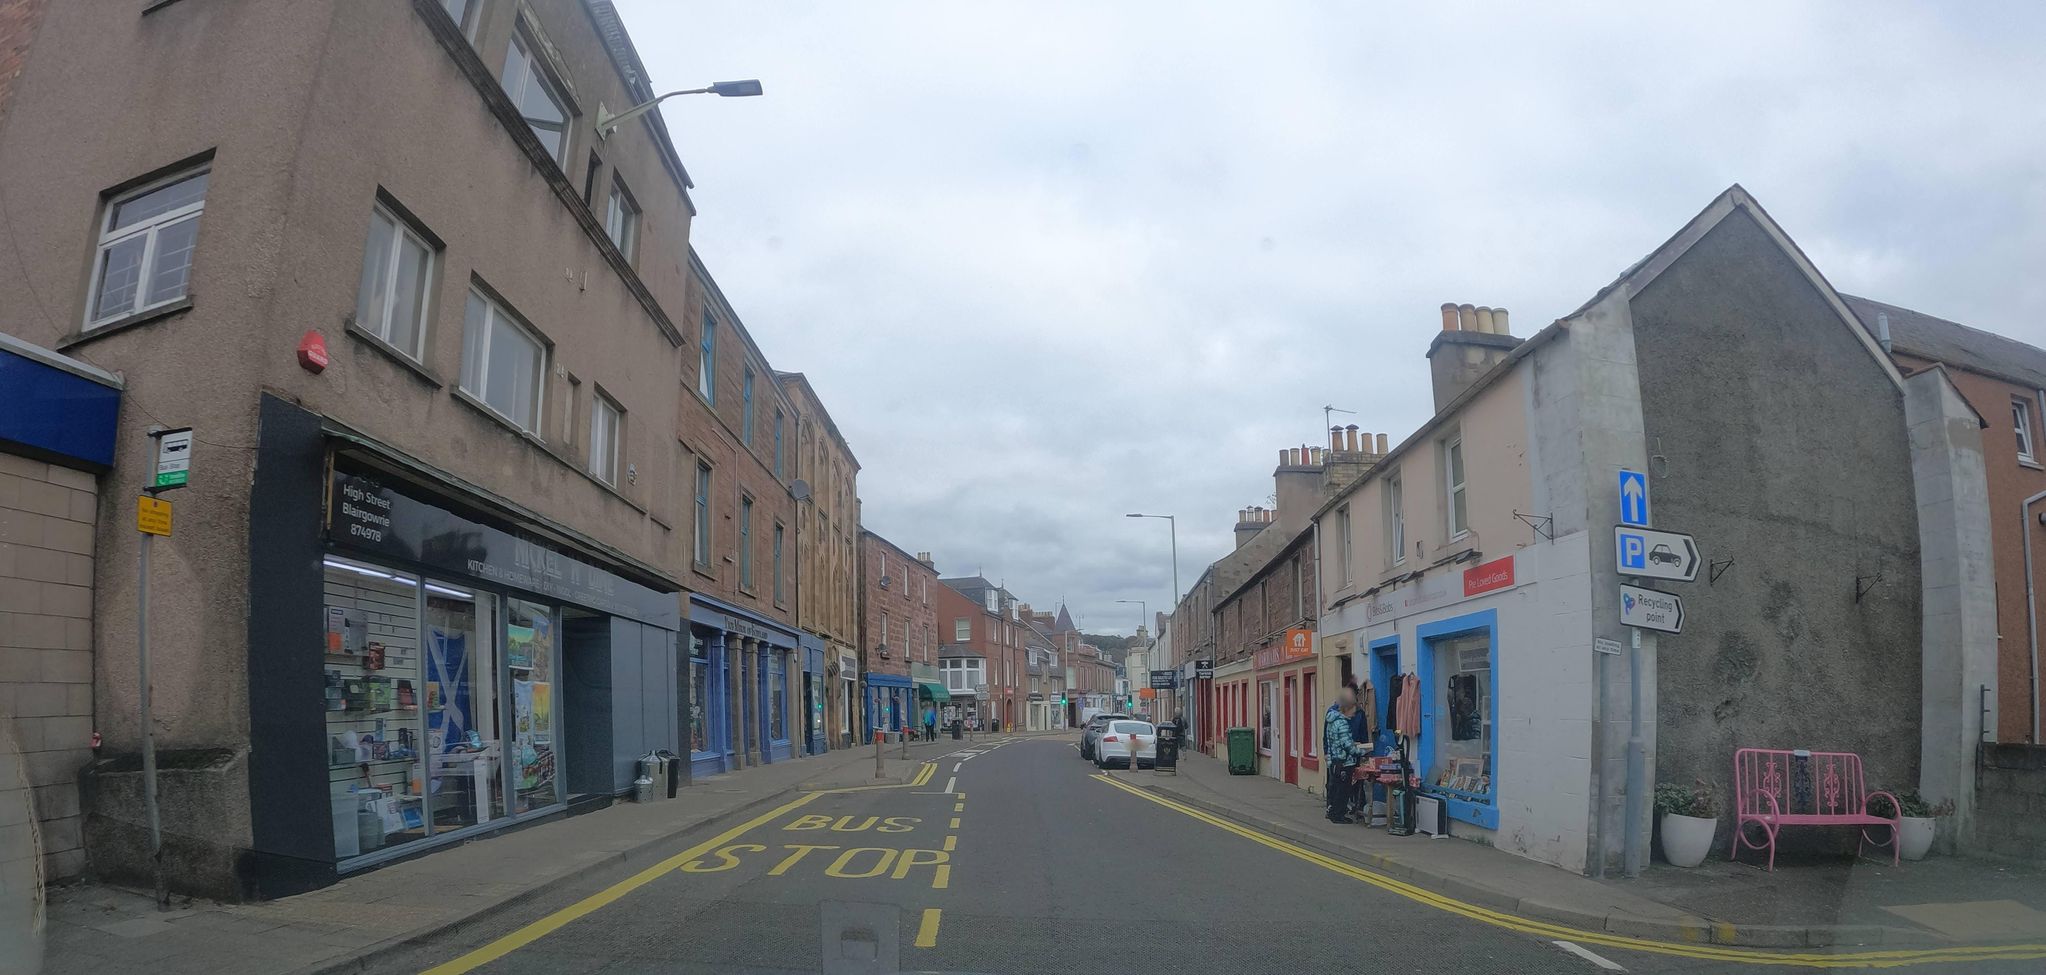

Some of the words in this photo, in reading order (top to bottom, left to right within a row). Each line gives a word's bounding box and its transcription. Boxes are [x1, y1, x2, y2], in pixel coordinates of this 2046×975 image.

[343, 484, 364, 502] High
[365, 492, 391, 510] Street
[342, 502, 390, 527] Blairgowrie
[350, 523, 382, 542] 874978
[1625, 537, 1642, 566] P
[467, 559, 499, 577] KITCHEN
[1477, 573, 1491, 587] Loved
[1492, 570, 1508, 583] Goods
[1638, 594, 1672, 612] Recycling
[1646, 611, 1664, 624] point
[783, 815, 922, 832] BUS
[681, 844, 950, 879] STOP
